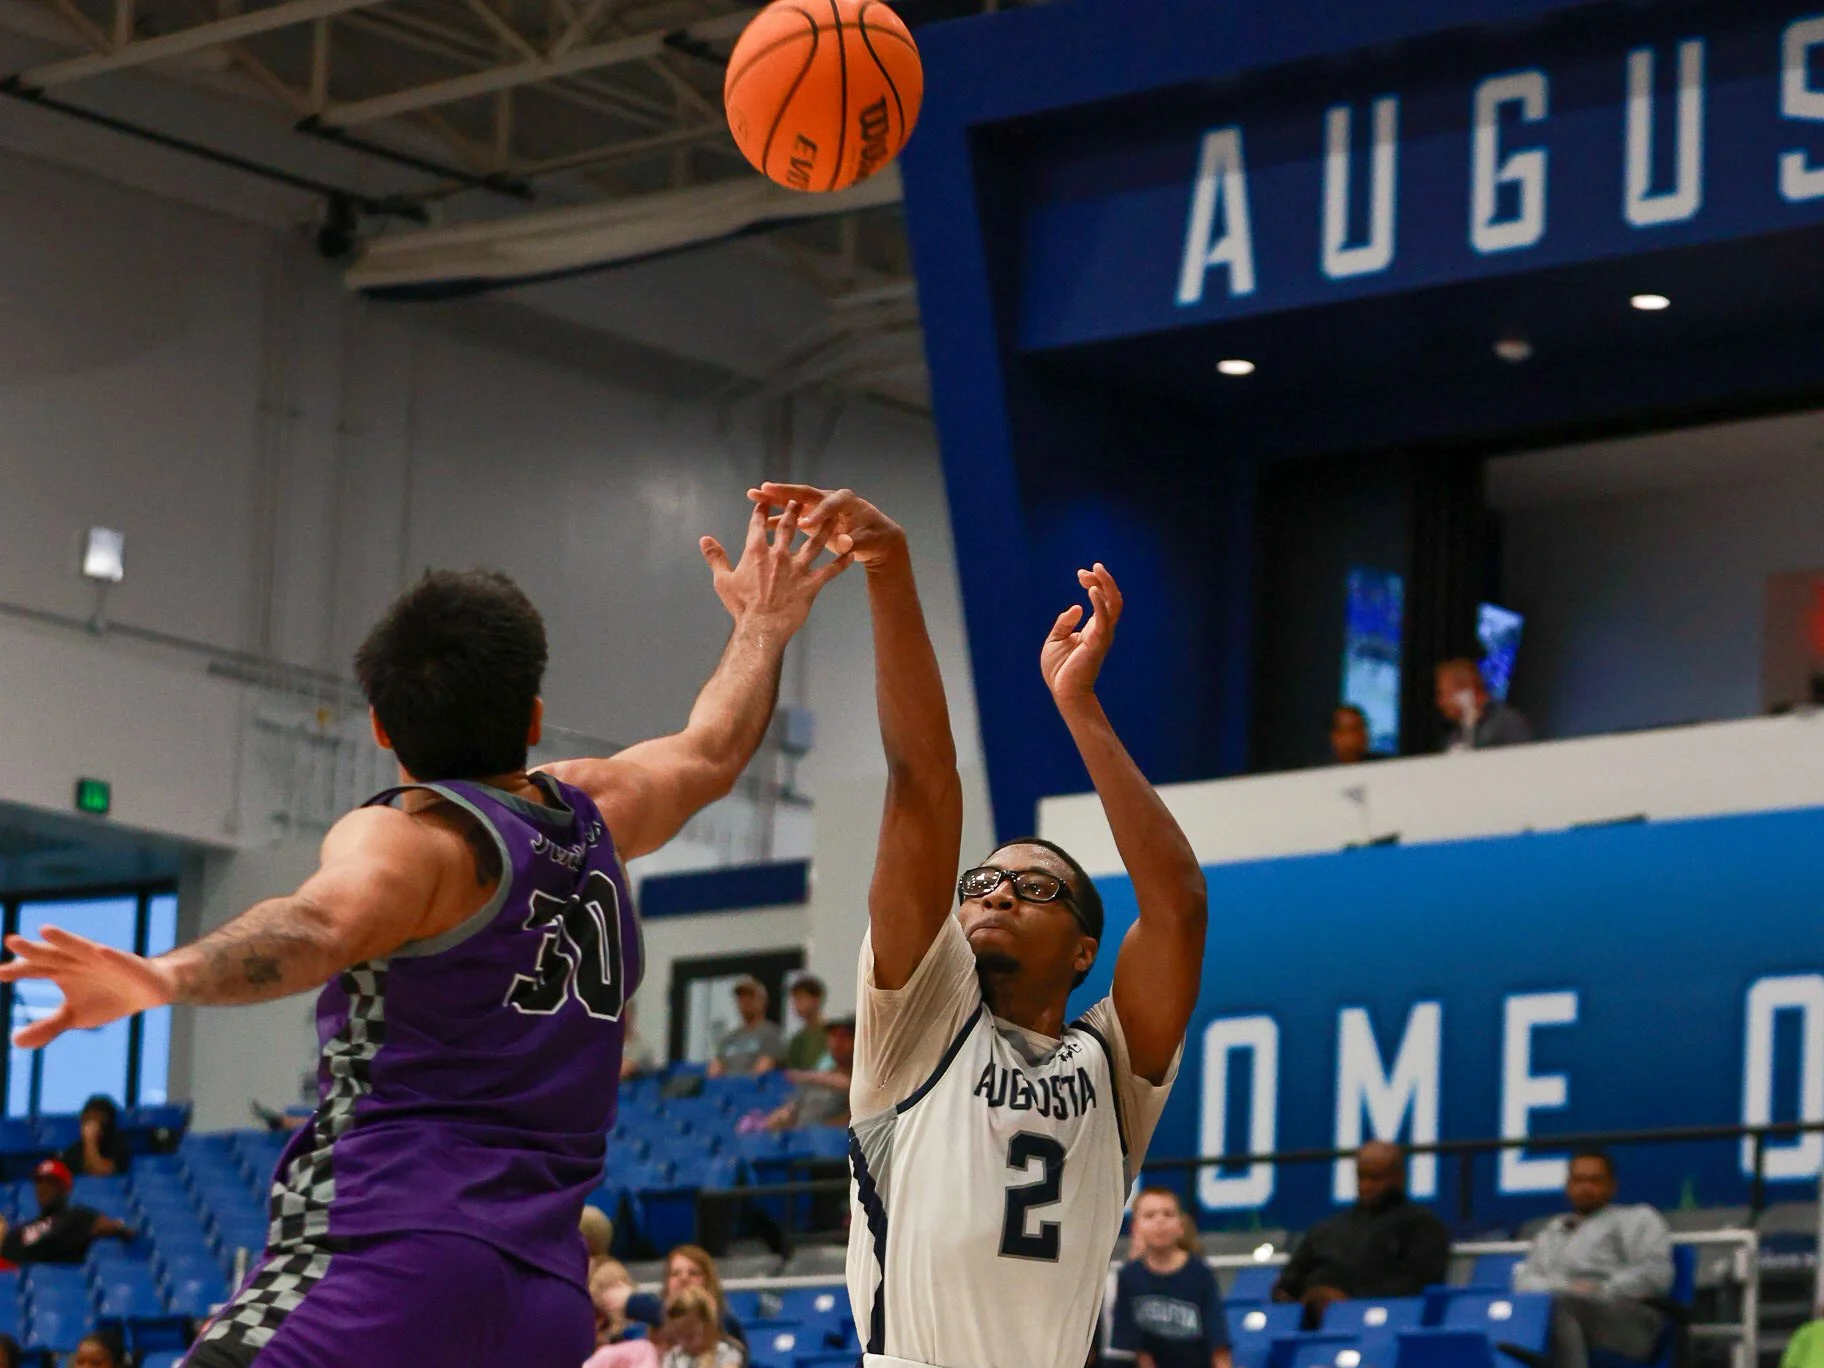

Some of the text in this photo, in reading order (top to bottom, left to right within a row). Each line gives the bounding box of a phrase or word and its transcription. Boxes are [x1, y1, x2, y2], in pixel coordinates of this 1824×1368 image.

[503, 869, 625, 1023] 30
[974, 1062, 1097, 1121] AUGUSTA
[1125, 990, 1580, 1212] OME
[997, 1129, 1066, 1263] 2
